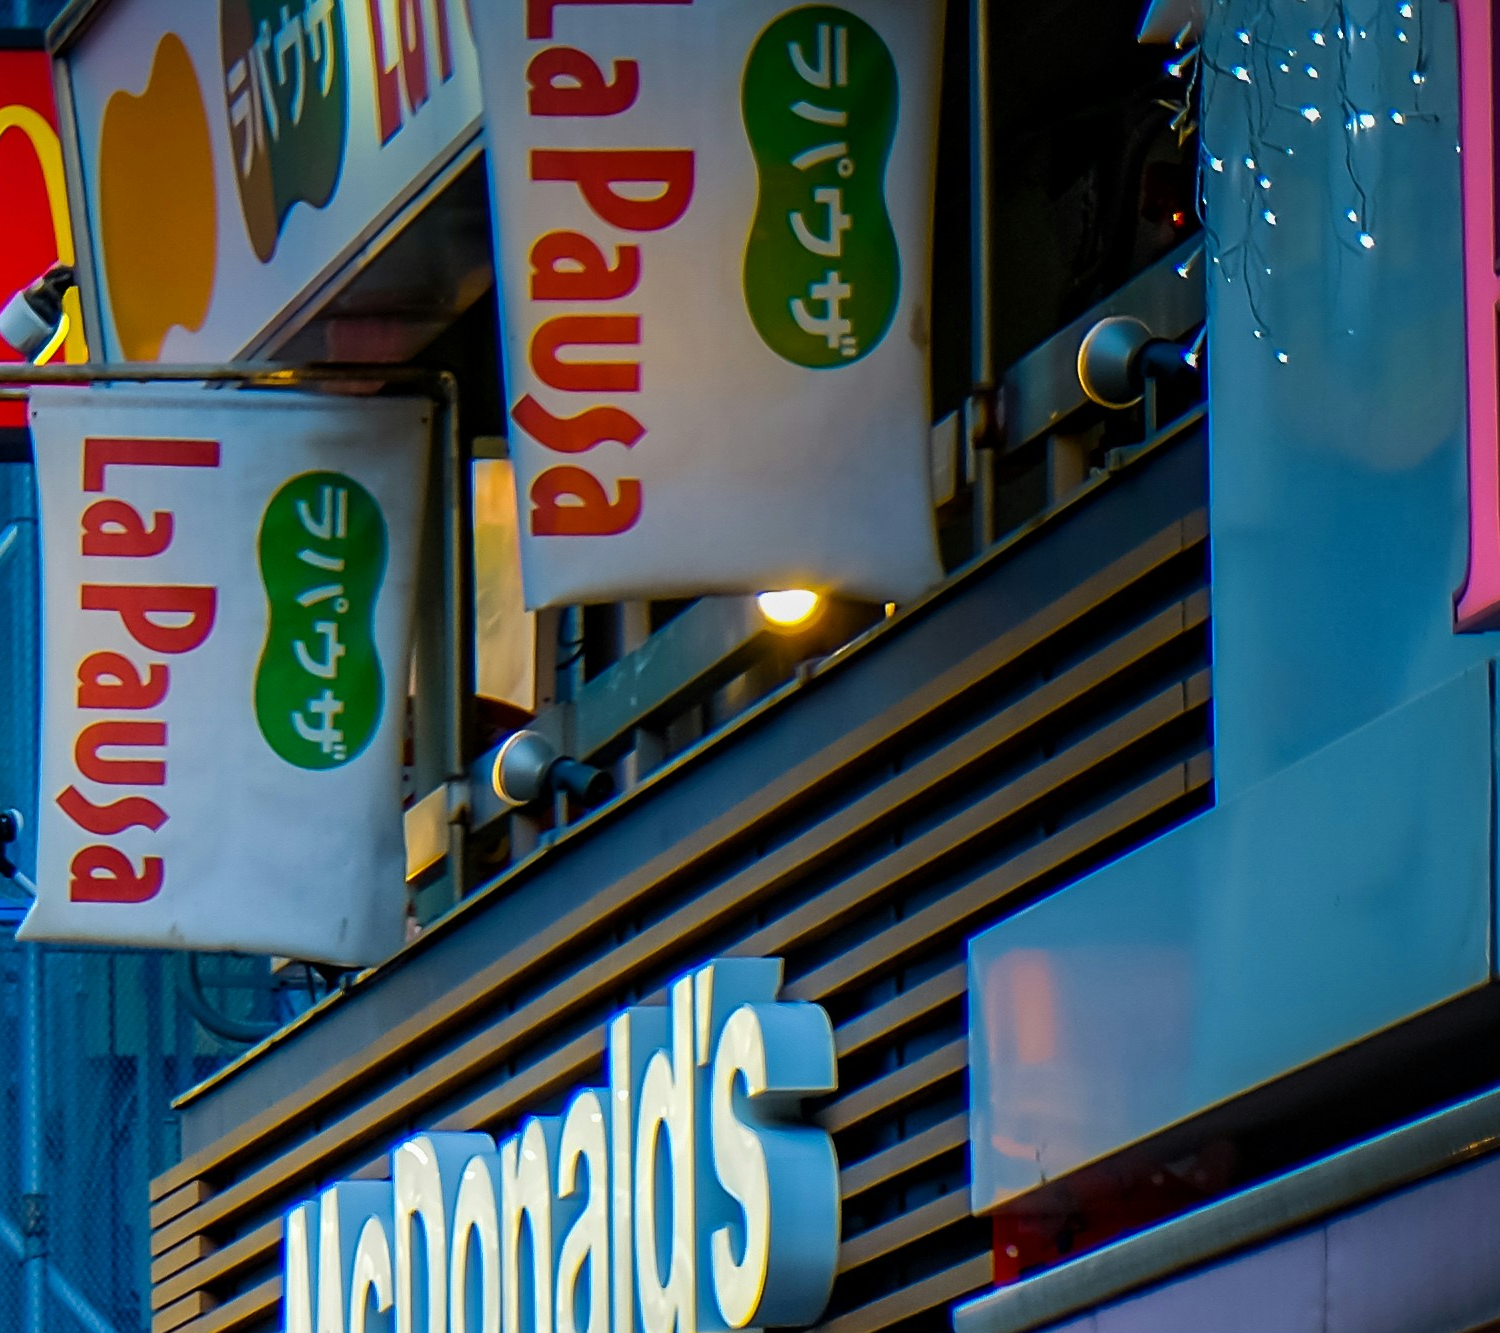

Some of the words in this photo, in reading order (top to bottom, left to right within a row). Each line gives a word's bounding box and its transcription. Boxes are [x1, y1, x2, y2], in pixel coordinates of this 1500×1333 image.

[788, 24, 852, 358] ラパウザ
[294, 486, 350, 762] ラパウザ
